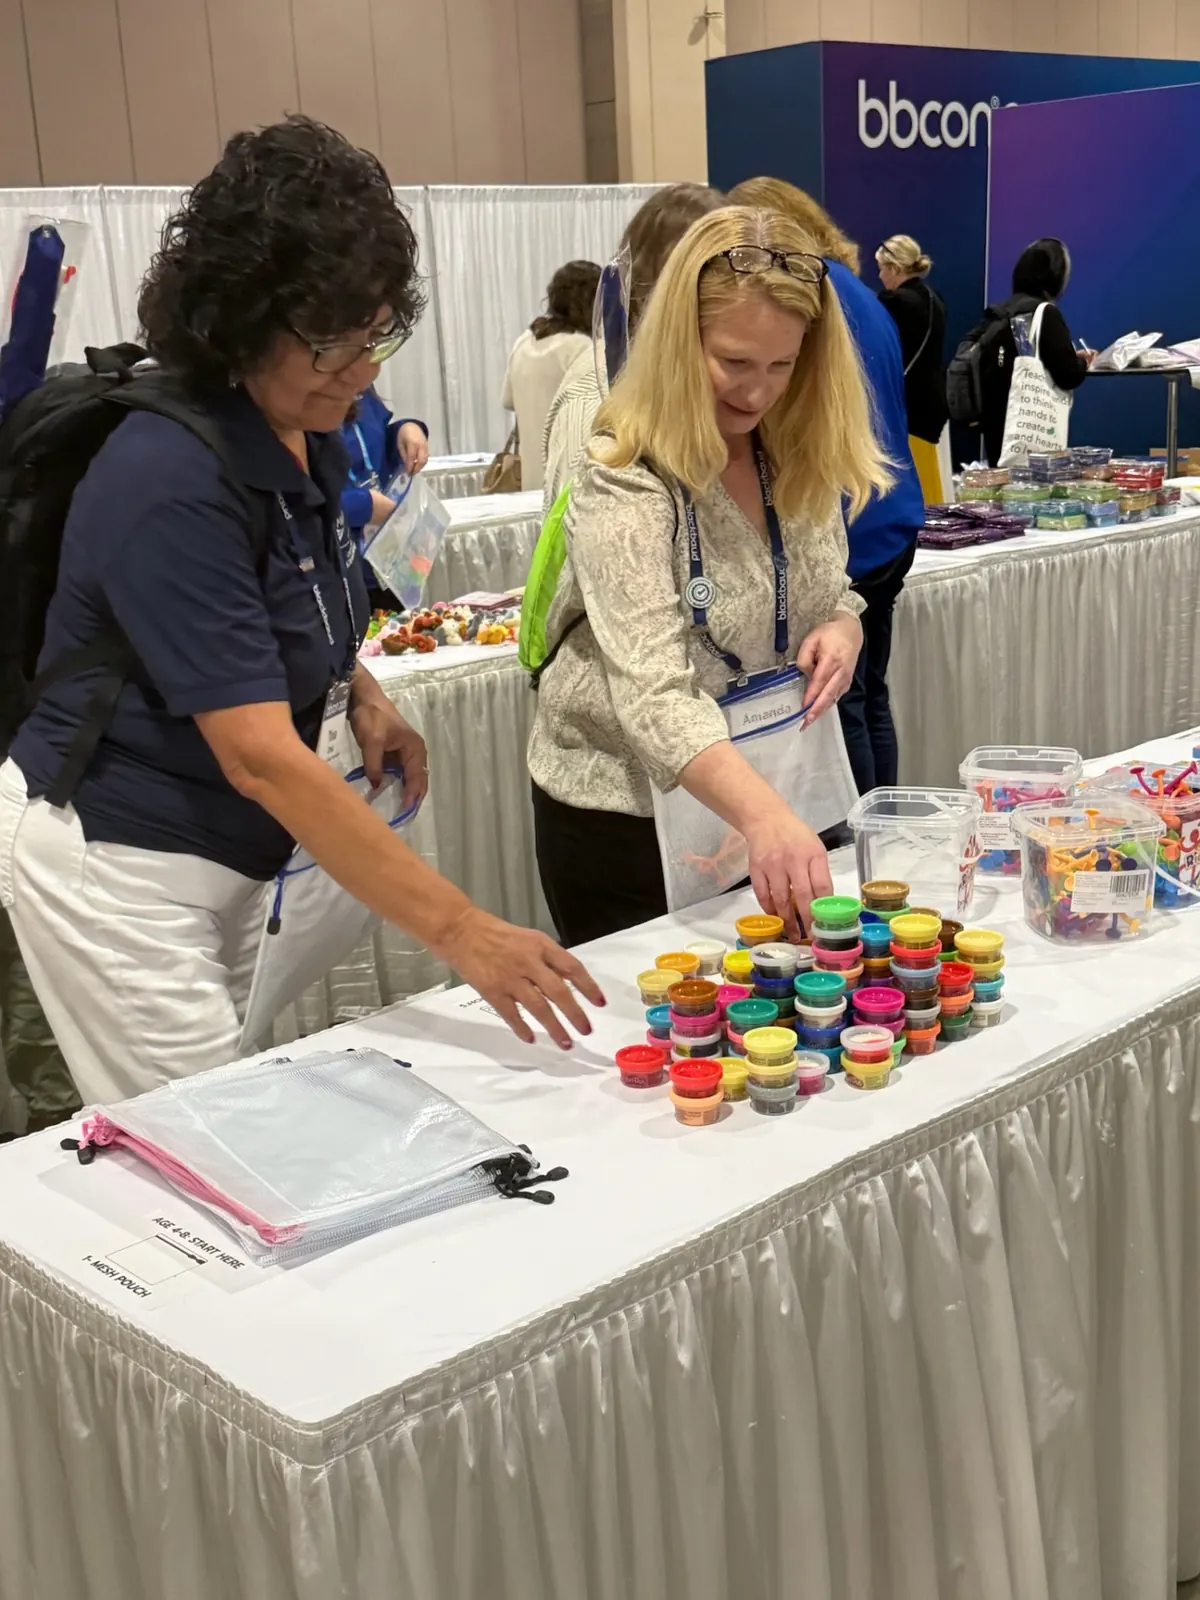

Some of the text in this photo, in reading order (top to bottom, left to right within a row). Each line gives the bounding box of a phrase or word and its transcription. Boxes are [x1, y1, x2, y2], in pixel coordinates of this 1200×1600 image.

[1020, 395, 1031, 404] to
[1018, 408, 1047, 421] hands
[1016, 421, 1047, 433] create
[1010, 444, 1021, 454] to
[1014, 434, 1034, 443] and
[1036, 436, 1063, 451] hearts
[742, 703, 792, 726] Amanda
[152, 1217, 176, 1229] AGE
[188, 1237, 221, 1255] START
[215, 1252, 246, 1270] HERE
[90, 1260, 120, 1278] MESH
[114, 1275, 152, 1298] POUCH
